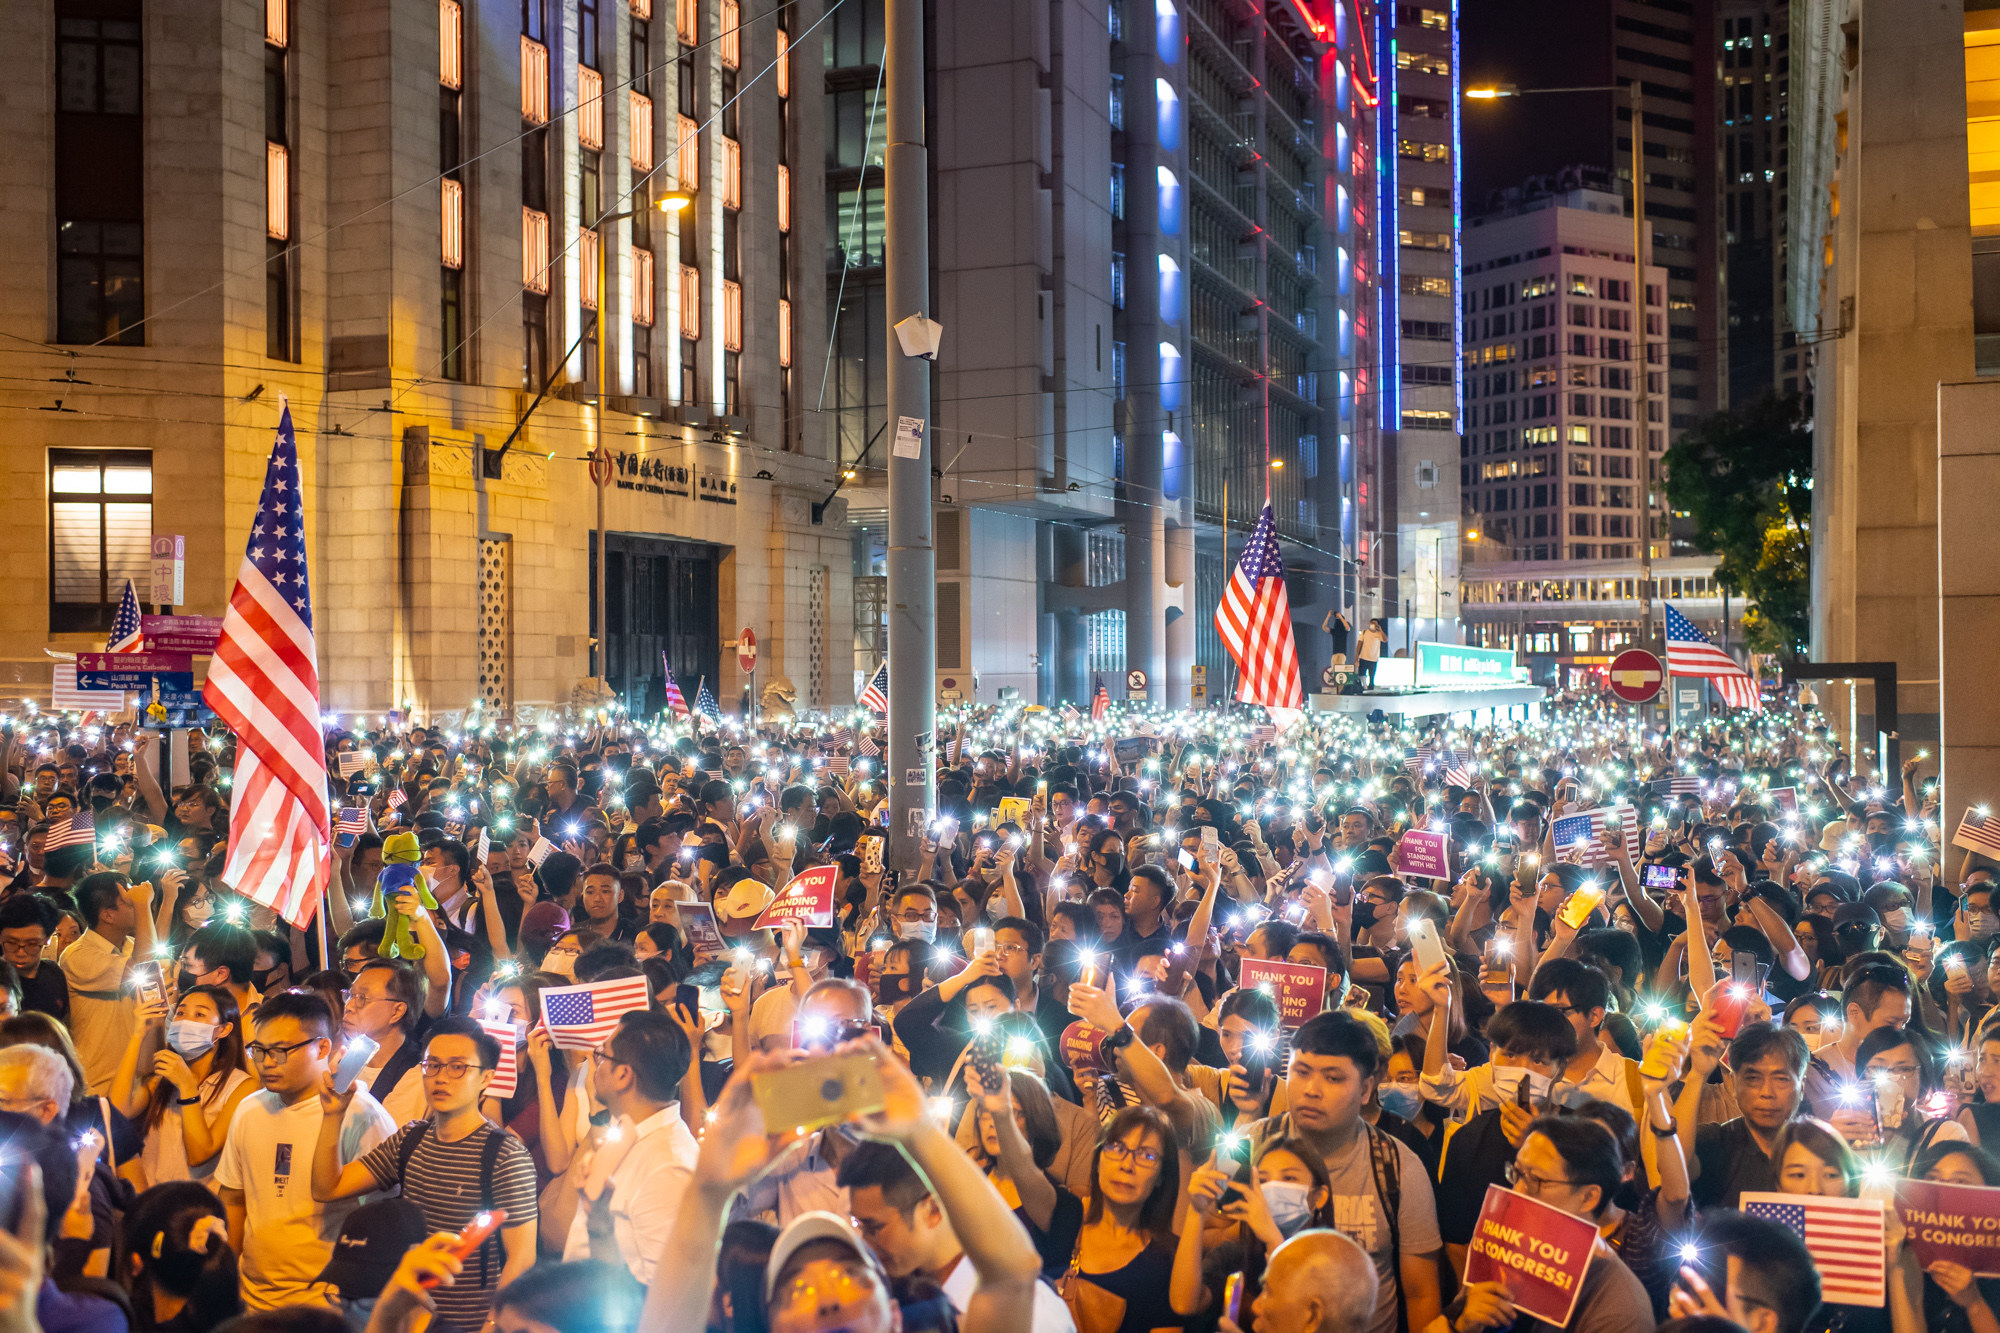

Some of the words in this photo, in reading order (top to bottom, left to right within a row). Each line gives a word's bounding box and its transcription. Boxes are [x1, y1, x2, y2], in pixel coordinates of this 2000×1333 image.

[618, 480, 634, 490] BANK
[636, 484, 644, 492] OF
[644, 484, 664, 494] CHINA
[154, 564, 172, 602] 中環
[1404, 836, 1422, 846] THANK
[1424, 840, 1438, 848] YOU
[1406, 852, 1436, 862] STANDING
[1408, 860, 1424, 868] WITH
[804, 876, 826, 886] YOU
[770, 896, 818, 910] STANDING
[770, 908, 792, 918] WITH
[796, 906, 814, 916] HK!
[1250, 970, 1286, 982] THANK
[1290, 974, 1314, 986] YOU
[1284, 1008, 1302, 1018] HK!
[1078, 1030, 1092, 1038] FOR
[1066, 1038, 1092, 1052] STANDING
[1904, 1208, 1966, 1230] THANK
[1970, 1216, 2000, 1232] YO
[1906, 1226, 1916, 1240] S
[1482, 1218, 1524, 1248] THANK
[1528, 1236, 1570, 1264] YOU
[1472, 1236, 1484, 1254] US
[1484, 1240, 1572, 1290] CONGRESS!
